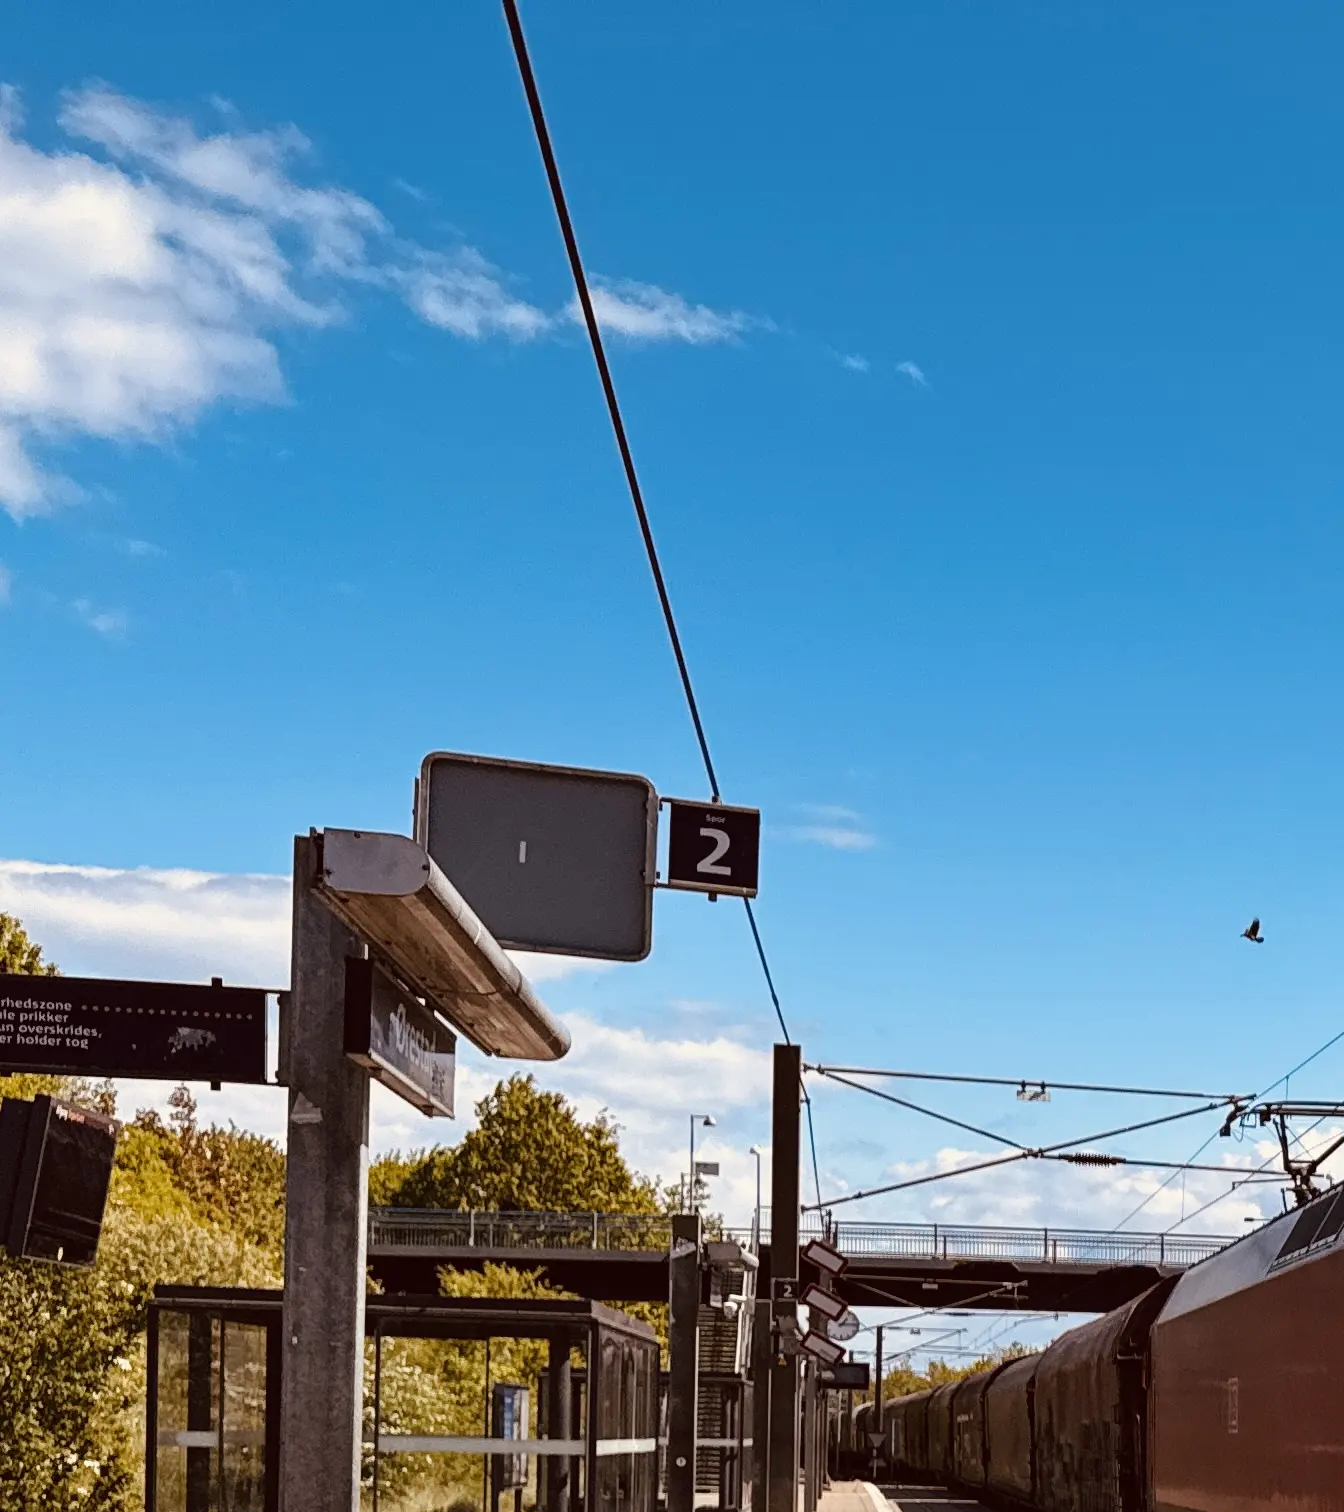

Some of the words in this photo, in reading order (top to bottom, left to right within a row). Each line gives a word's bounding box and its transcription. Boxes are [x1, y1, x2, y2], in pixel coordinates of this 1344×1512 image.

[697, 827, 732, 877] 2
[20, 1010, 69, 1024] prikker
[19, 1024, 102, 1039] overskrides,
[17, 1033, 62, 1047] holder
[66, 1037, 89, 1050] tog
[783, 1284, 793, 1298] 2
